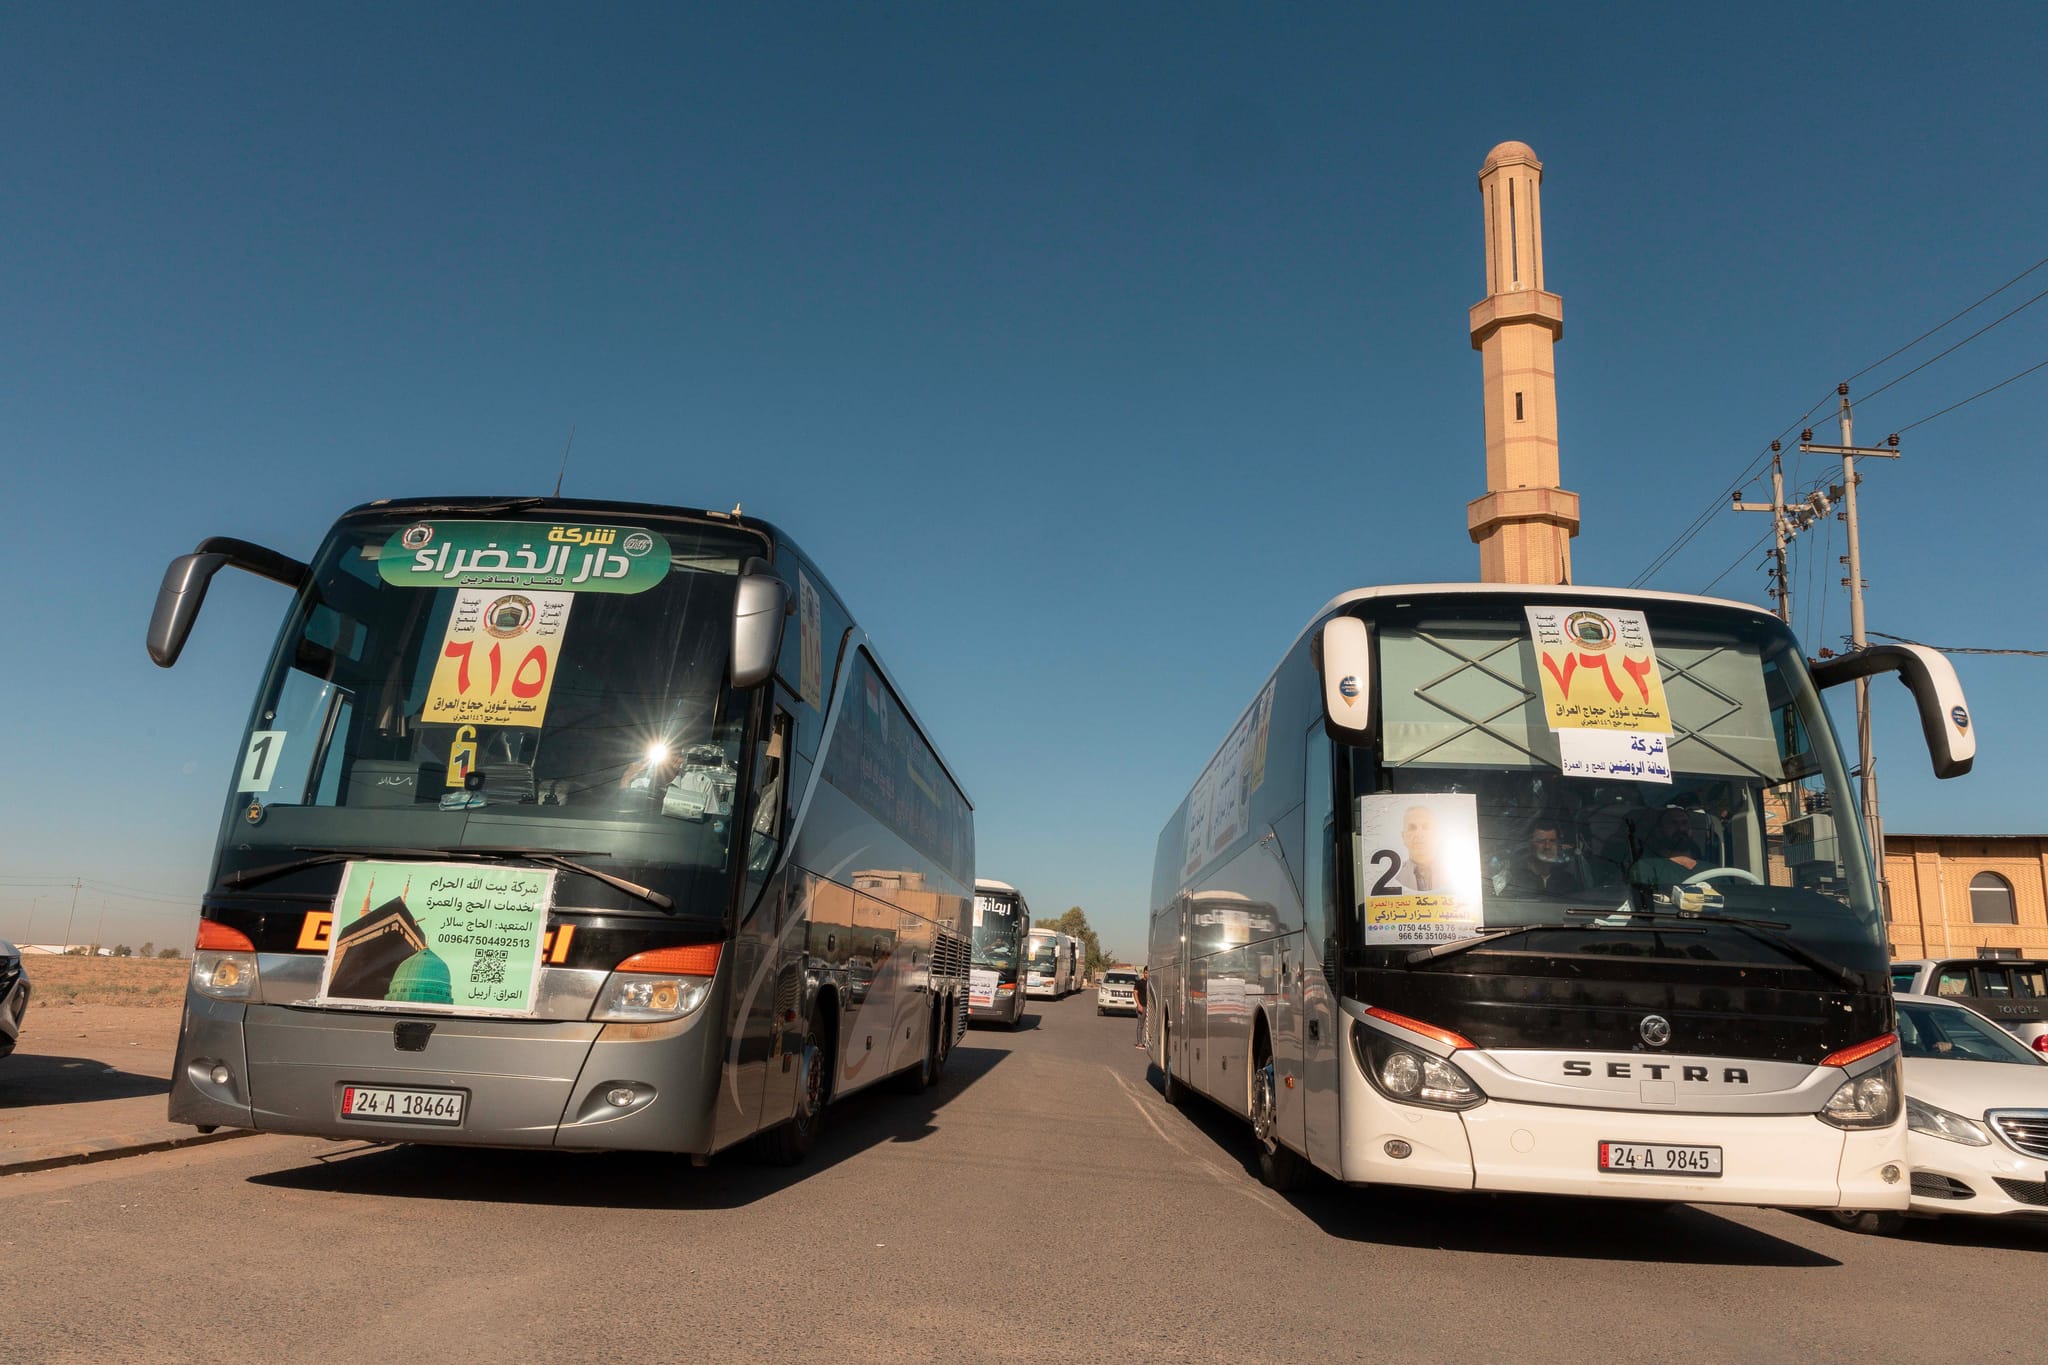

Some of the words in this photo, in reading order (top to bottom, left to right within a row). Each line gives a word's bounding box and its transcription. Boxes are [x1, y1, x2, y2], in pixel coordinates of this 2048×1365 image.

[548, 526, 617, 547] شركة
[411, 542, 570, 579] الخضراء
[571, 547, 630, 583] دار
[460, 574, 519, 586] المسافرين
[444, 640, 548, 699] ٦١٥
[1542, 651, 1651, 705] ٧٦٢
[433, 697, 459, 711] العراق
[459, 699, 483, 713] حجاج
[508, 701, 537, 715] مكتب
[1556, 703, 1581, 717] العراق
[1582, 704, 1606, 718] حجاج
[1632, 707, 1660, 720] مكتب
[1631, 735, 1664, 756] شركة
[252, 736, 273, 781] 1
[1370, 849, 1403, 897] 2
[429, 877, 464, 892] الحرام
[466, 876, 483, 890] الله
[485, 882, 508, 895] بيت
[511, 881, 538, 897] شركة
[426, 896, 463, 911] والعمرة
[465, 899, 491, 913] الحج
[494, 900, 535, 912] لخدمات
[440, 916, 464, 929] سالار
[466, 918, 493, 932] الحاج
[1418, 923, 1432, 932] 445
[438, 933, 530, 948] 009647504492513
[1562, 1060, 1750, 1084] SETRA
[357, 1092, 378, 1112] 24
[384, 1093, 395, 1113] A
[401, 1095, 455, 1117] 18464
[1614, 1147, 1636, 1167] 24
[1644, 1148, 1655, 1168] A
[1666, 1150, 1710, 1170] 9845
